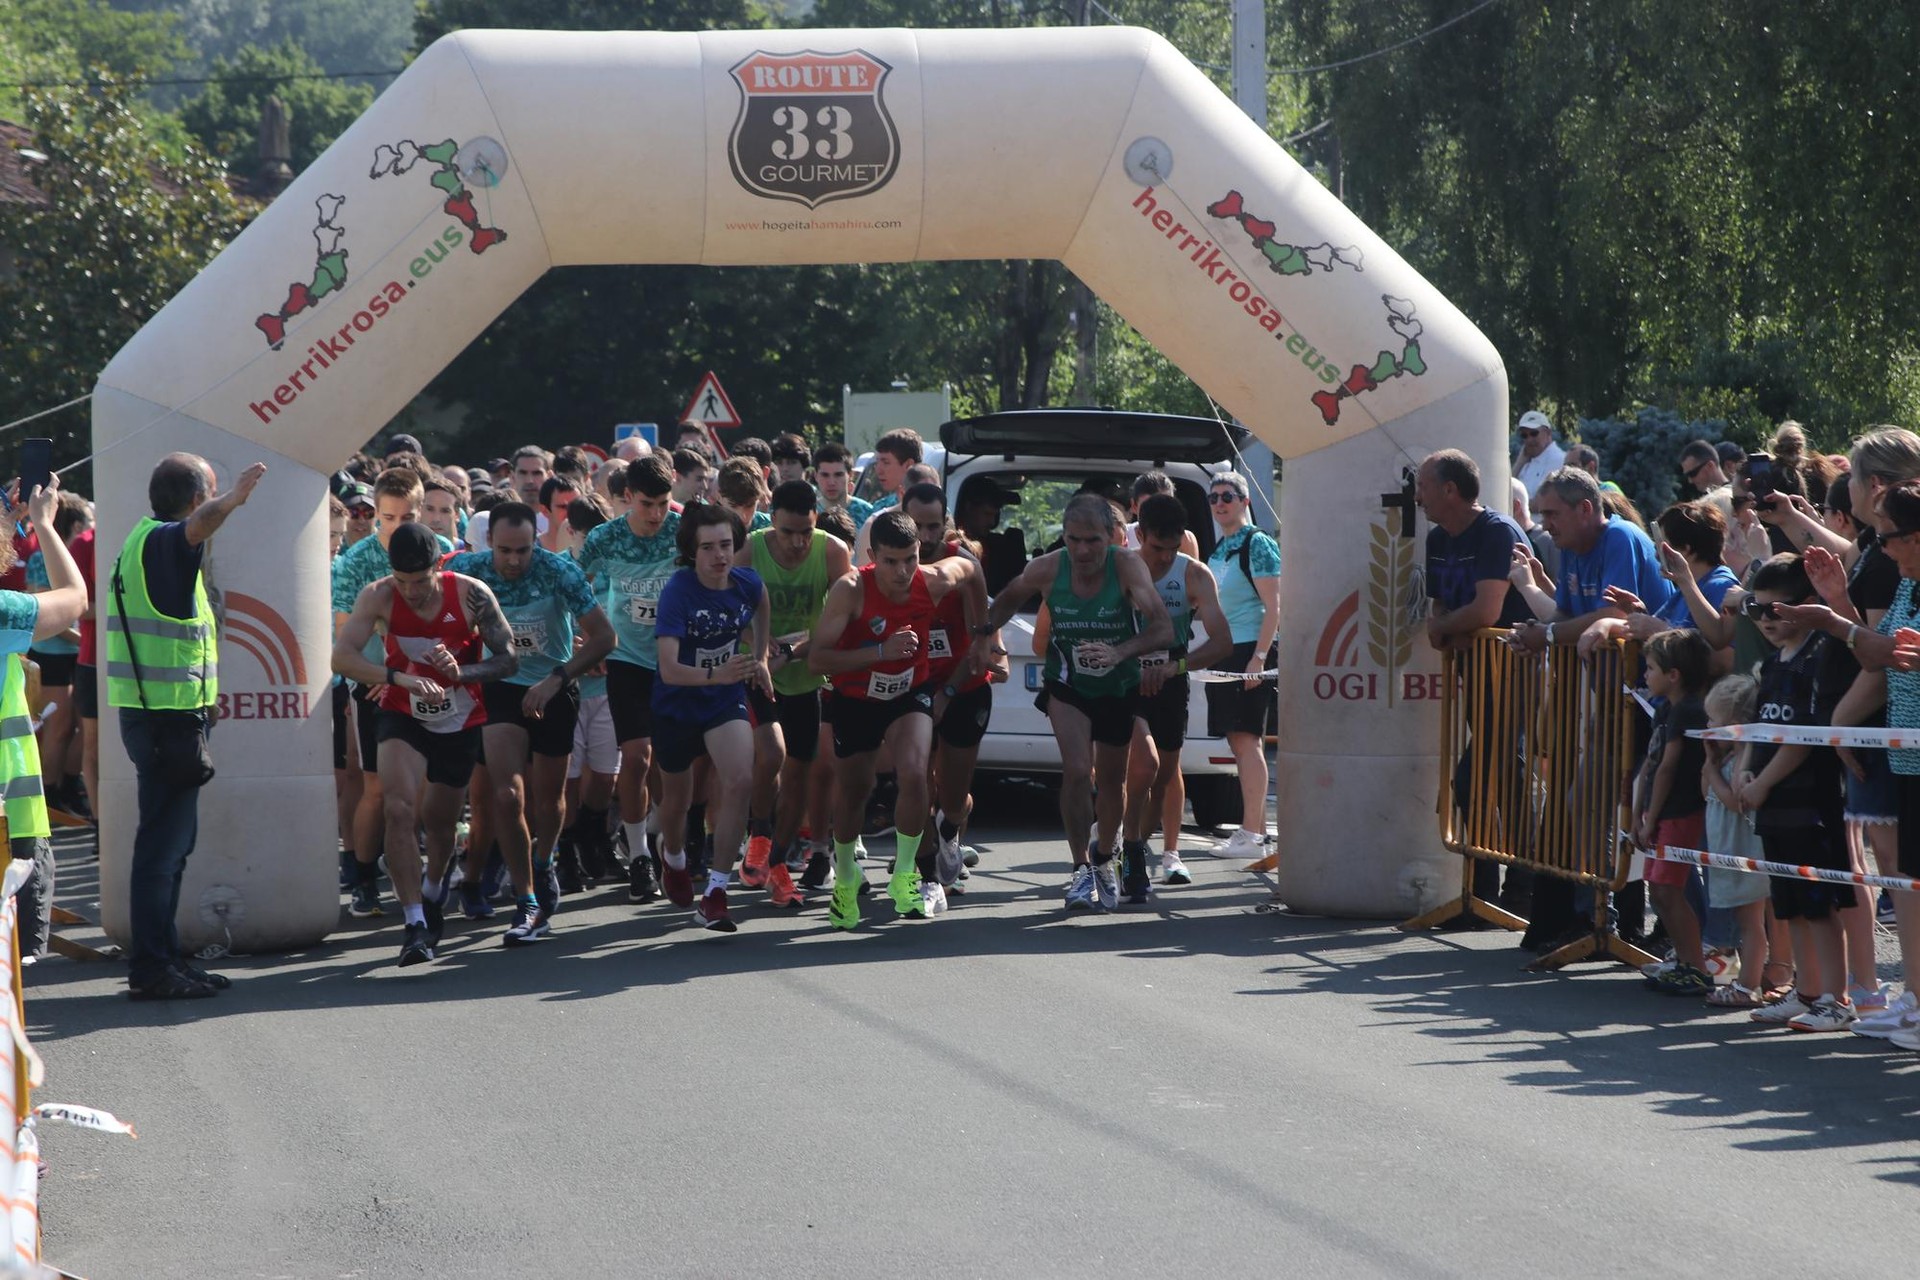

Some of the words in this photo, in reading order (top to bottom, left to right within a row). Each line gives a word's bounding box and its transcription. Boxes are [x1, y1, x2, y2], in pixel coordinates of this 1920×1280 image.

[753, 65, 869, 88] ROUTE
[771, 105, 854, 160] 33
[759, 164, 885, 182] GOURMET
[725, 219, 902, 233] www.hogeitahamahiru.com
[1132, 186, 1343, 385] herrikrosa.eus
[249, 225, 464, 424] herrikrosa.eus
[638, 606, 657, 619] 71
[514, 637, 533, 647] 28
[1313, 672, 1378, 700] OGI
[216, 692, 310, 719] BERRI
